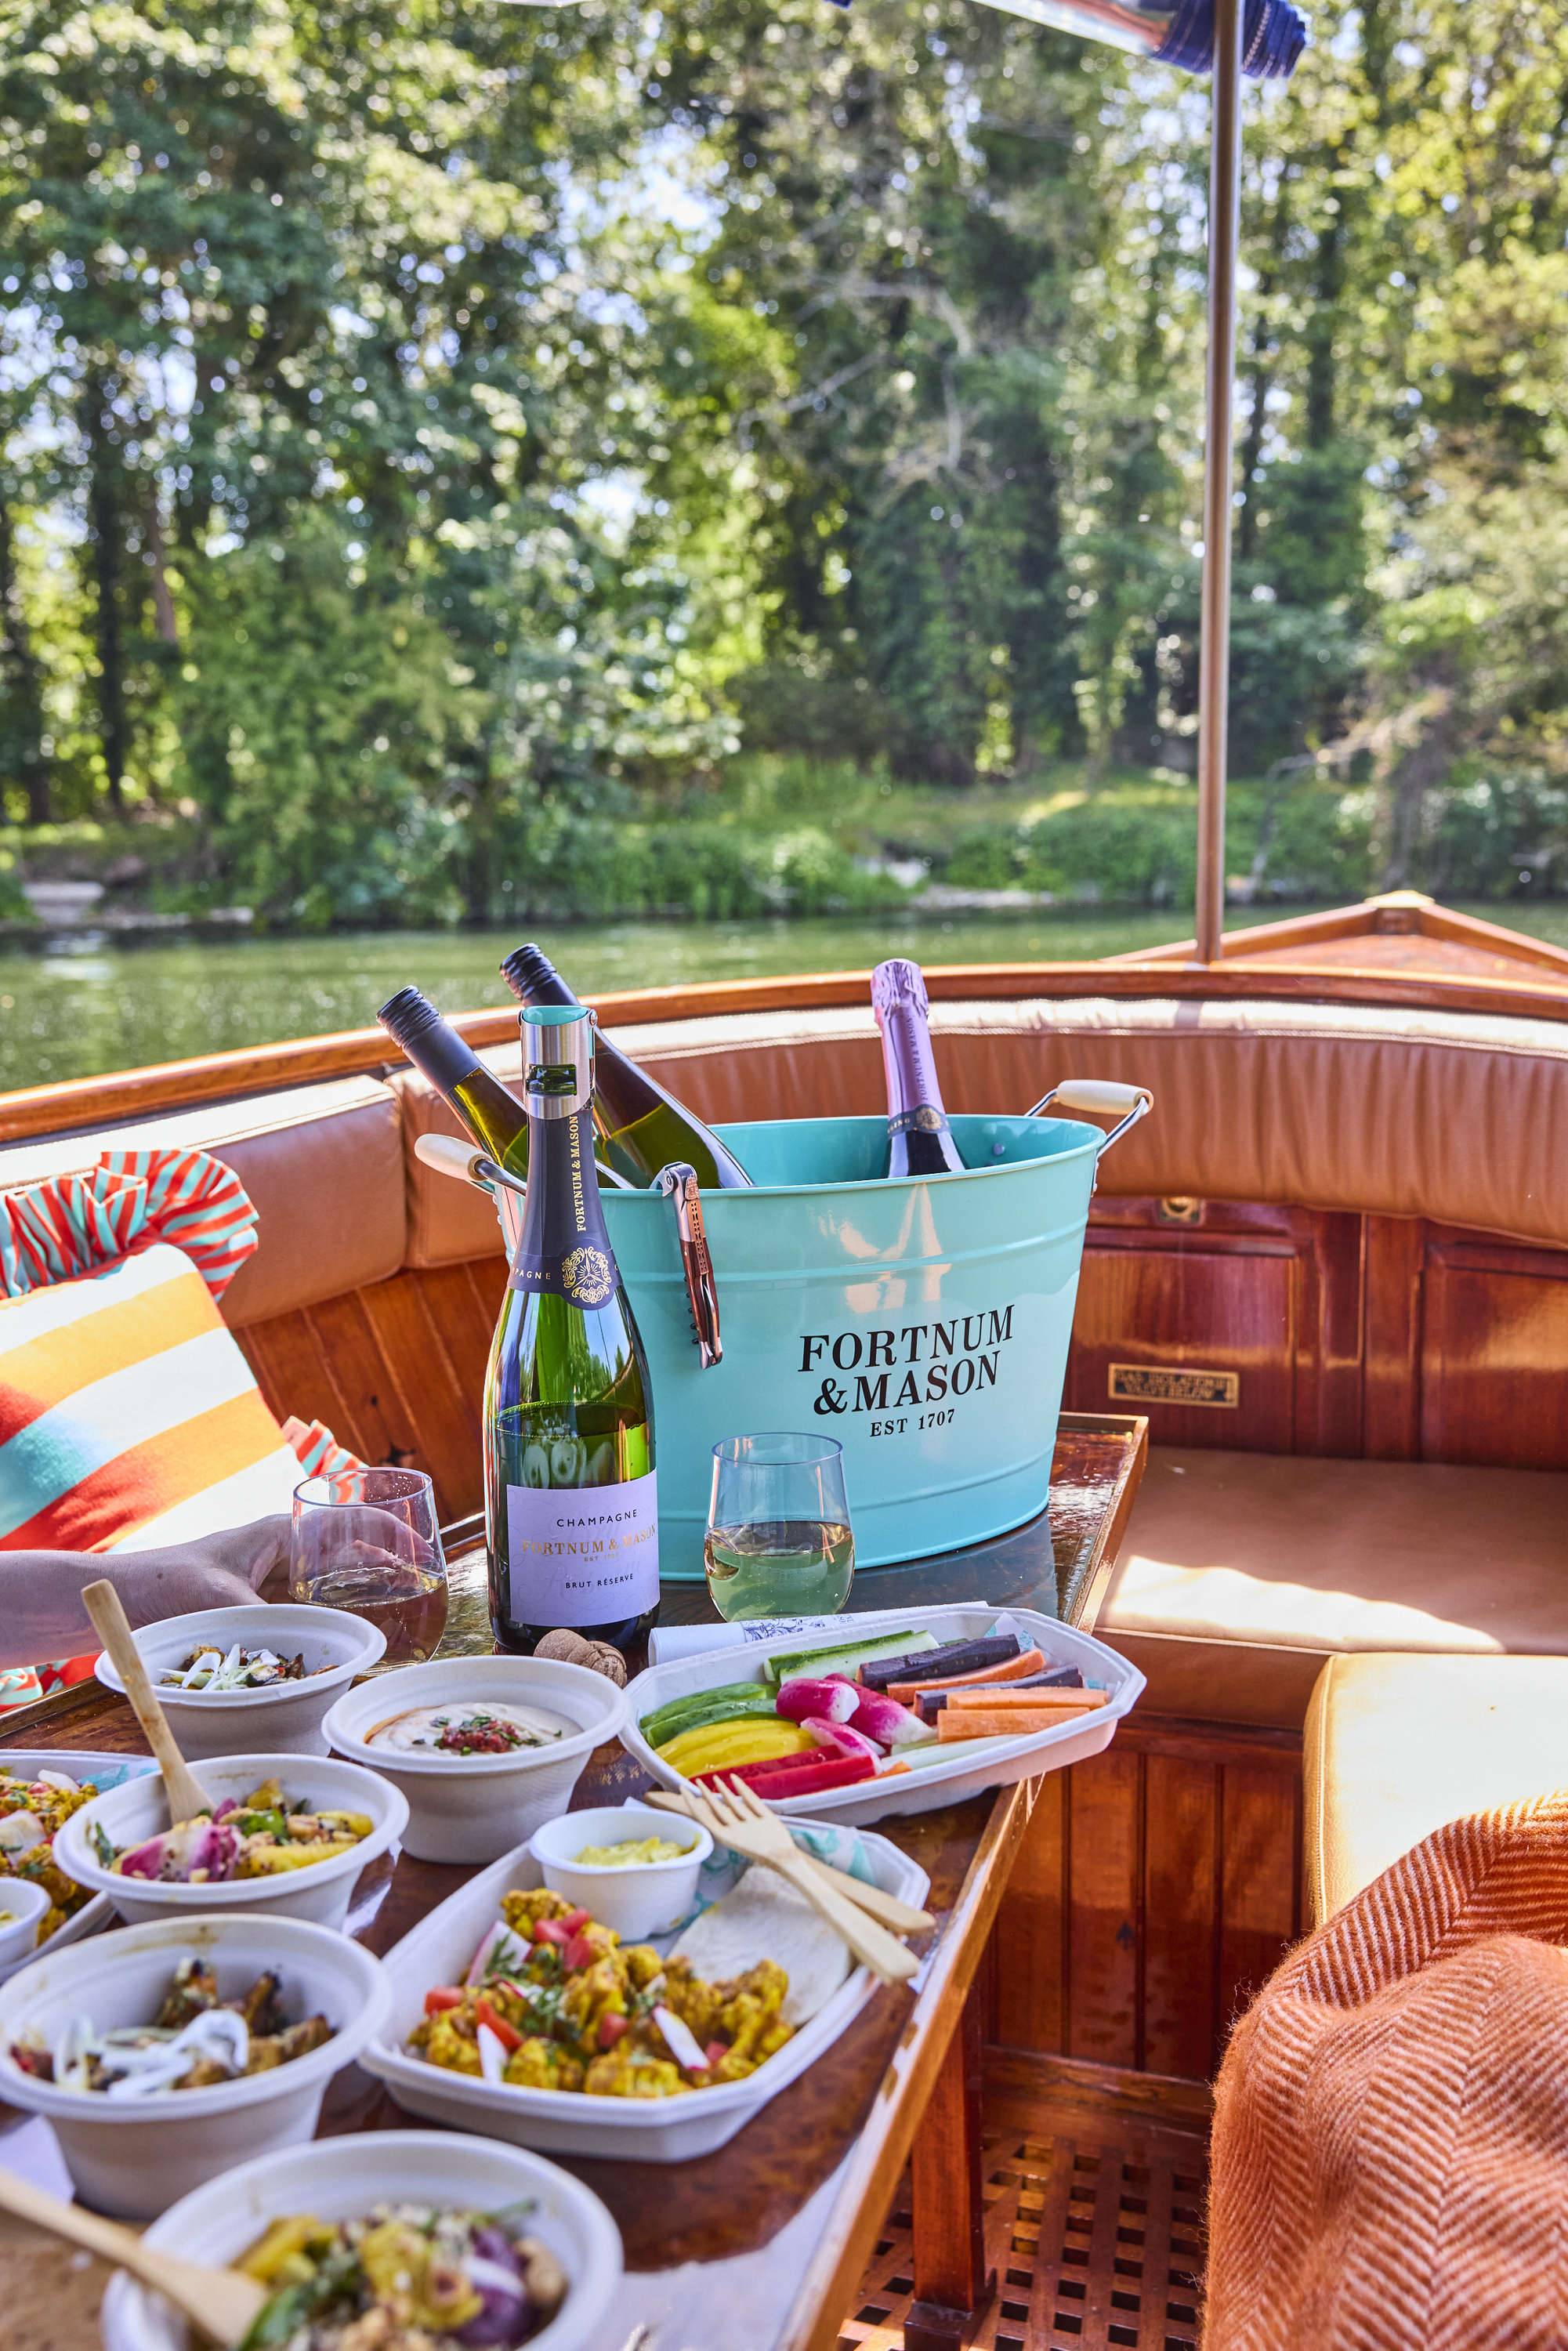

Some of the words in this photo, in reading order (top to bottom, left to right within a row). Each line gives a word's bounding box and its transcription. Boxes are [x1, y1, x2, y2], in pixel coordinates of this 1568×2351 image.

[906, 1017, 918, 1048] MASON
[913, 1056, 929, 1100] FORTNUM
[569, 1115, 580, 1158] MASON
[571, 1160, 581, 1169] &
[572, 1171, 587, 1232] FORTNUM
[798, 1304, 1015, 1372] FORTNUM
[870, 1418, 908, 1437] EST
[918, 1408, 955, 1430] 1707
[556, 1509, 638, 1527] CHAMPAGNE
[522, 1539, 604, 1556] FORTNUM
[608, 1538, 619, 1551] &
[622, 1523, 656, 1549] MASON
[565, 1581, 592, 1589] BRUT
[597, 1573, 634, 1587] RÉSERVE
